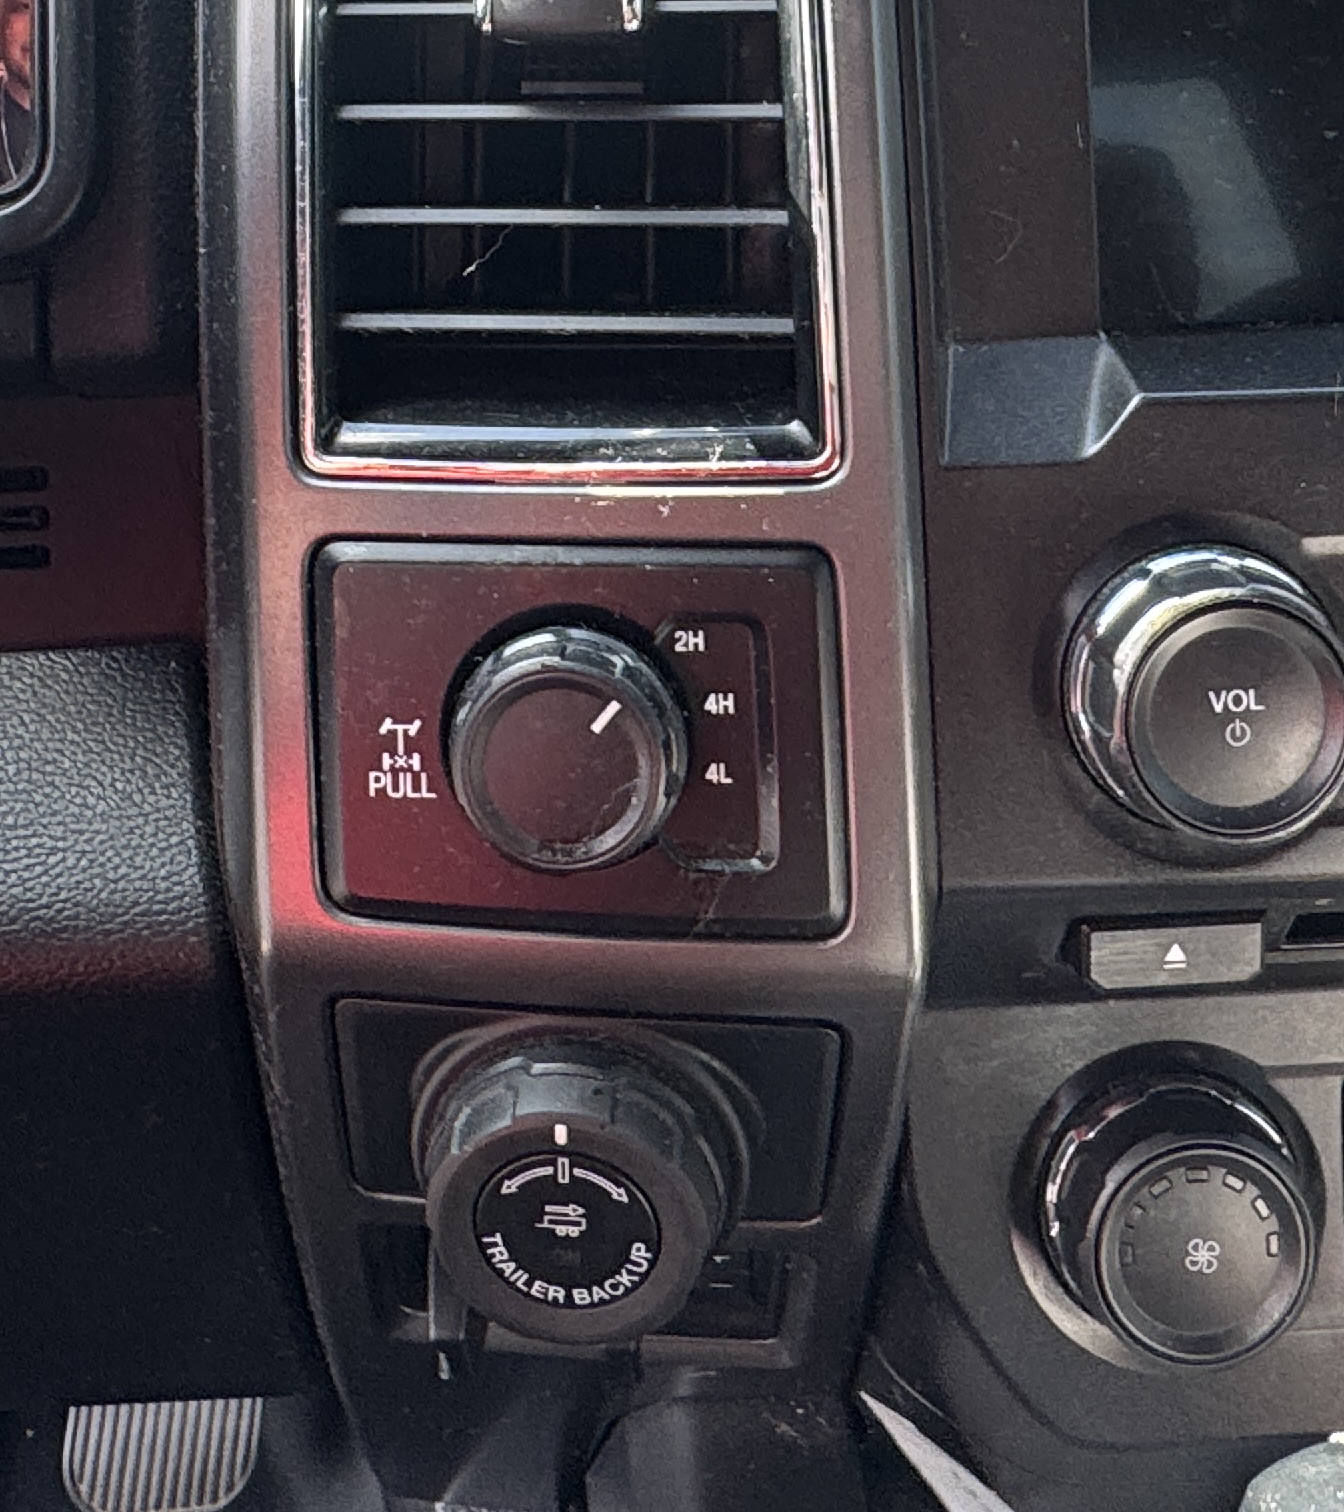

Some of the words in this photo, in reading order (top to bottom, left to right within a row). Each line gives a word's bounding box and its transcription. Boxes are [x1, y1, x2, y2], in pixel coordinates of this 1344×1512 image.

[674, 629, 705, 652] 2H
[704, 692, 736, 716] 4H
[1208, 688, 1266, 714] VOL
[368, 770, 437, 799] PULL
[705, 762, 733, 785] 4L
[481, 1232, 566, 1304] TRAILER
[571, 1242, 654, 1306] BACKUP
